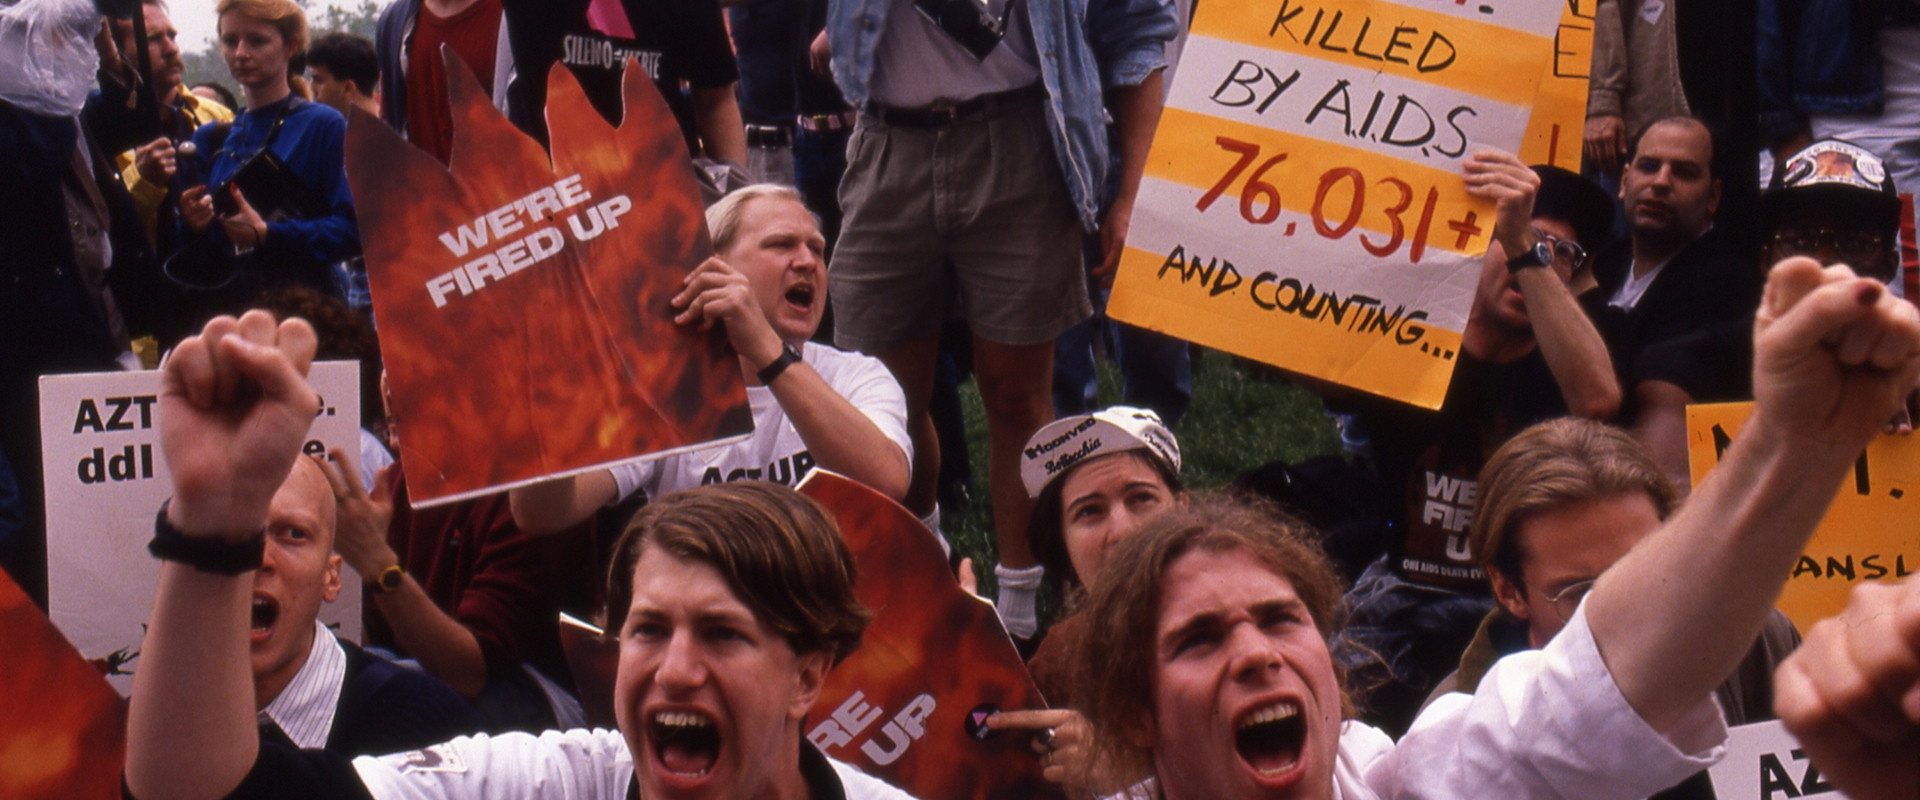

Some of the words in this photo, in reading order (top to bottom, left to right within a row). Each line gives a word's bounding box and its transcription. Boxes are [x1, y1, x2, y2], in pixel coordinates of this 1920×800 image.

[1269, 0, 1456, 73] KILLED
[1209, 60, 1300, 114] BY
[425, 226, 565, 309] FIRED
[567, 194, 632, 242] UP
[438, 173, 592, 258] WE'RE
[74, 395, 157, 434] AZT
[1403, 559, 1420, 571] ONE
[1421, 562, 1439, 574] AIDS
[1441, 567, 1469, 578] DEATH
[860, 693, 937, 766] UP
